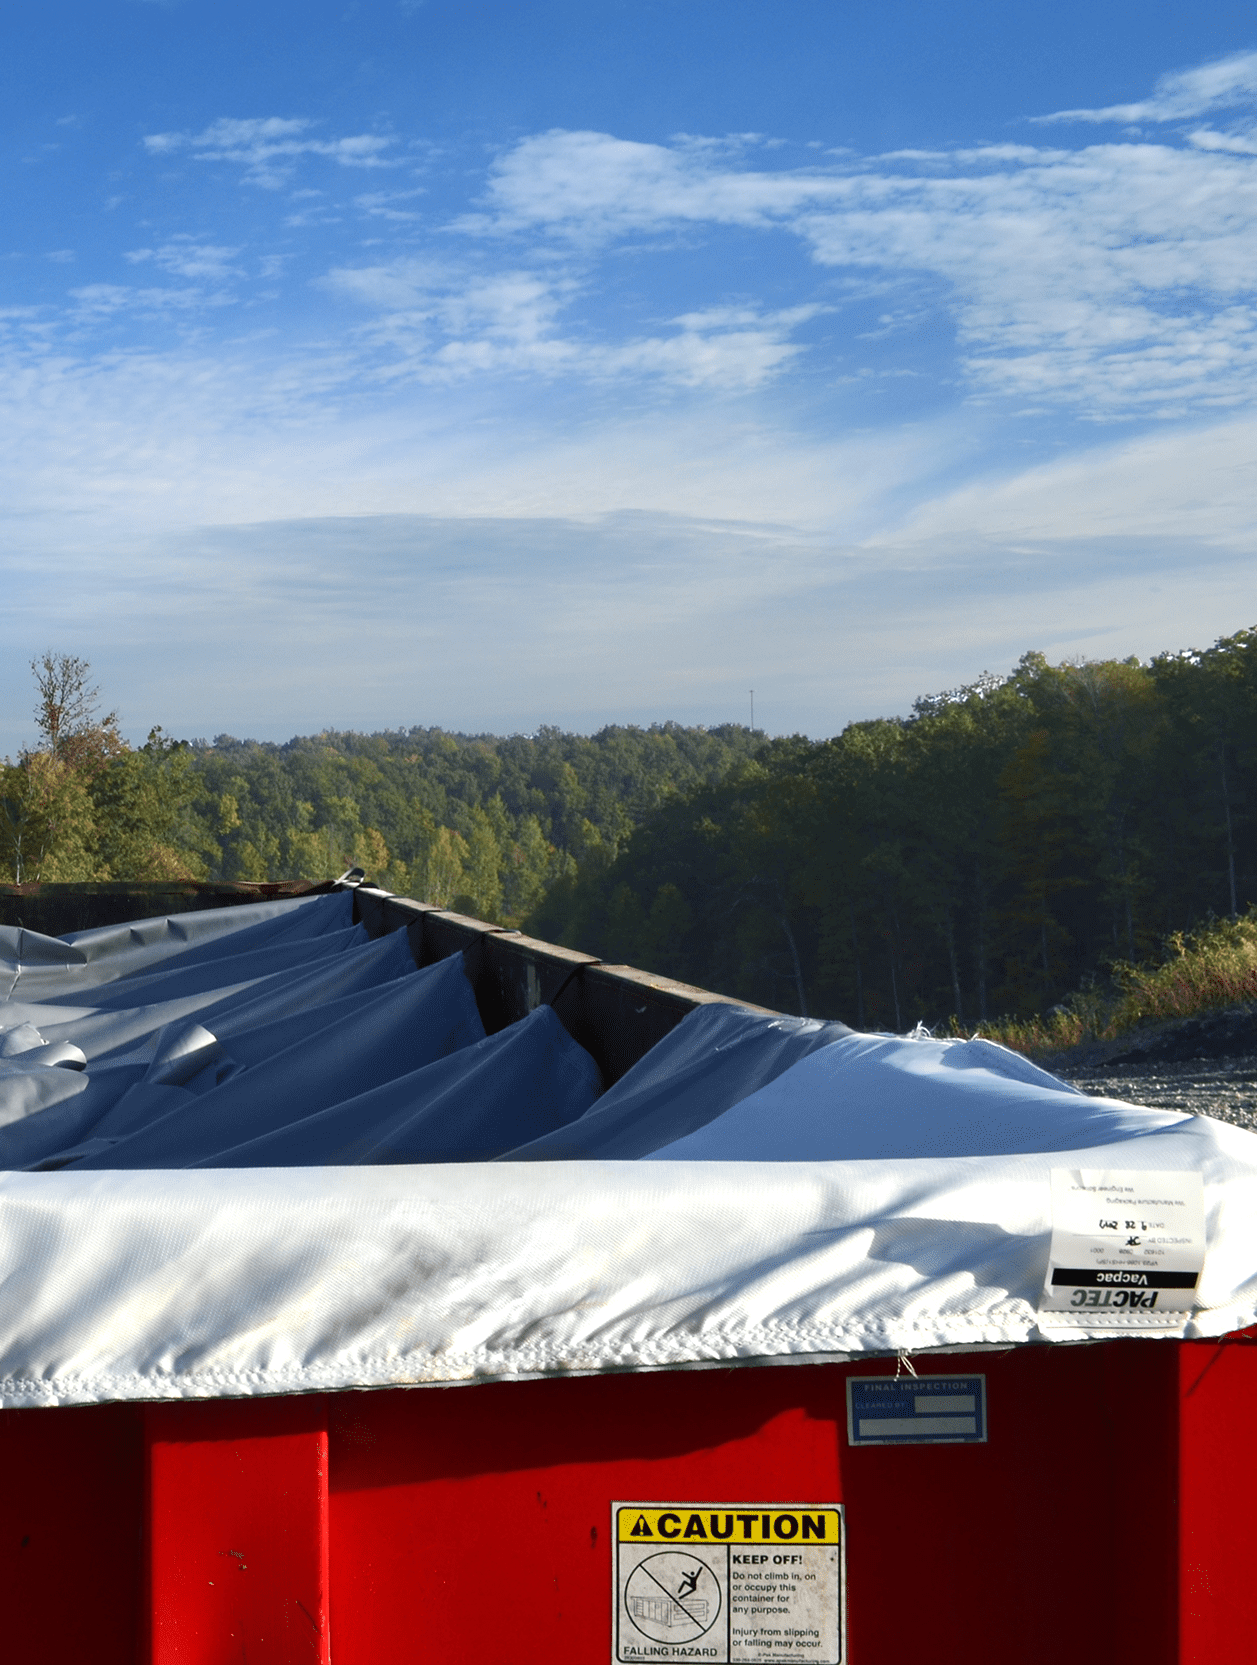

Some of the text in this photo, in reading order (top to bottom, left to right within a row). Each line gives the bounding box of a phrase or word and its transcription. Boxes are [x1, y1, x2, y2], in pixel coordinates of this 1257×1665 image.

[1106, 1197, 1137, 1205] Packaging
[1096, 1271, 1148, 1286] Vacpac
[1070, 1289, 1159, 1308] PACTEC
[864, 1382, 968, 1392] FINAL INSPECTION
[657, 1513, 826, 1539] CAUTION
[732, 1555, 802, 1564] KEEP OFF!
[732, 1572, 745, 1580] Do
[764, 1572, 789, 1580] climb
[791, 1572, 802, 1581] in,
[744, 1584, 777, 1592] occupy
[751, 1607, 790, 1615] purpose.
[732, 1628, 758, 1637] Injury
[784, 1628, 819, 1638] slipping
[744, 1639, 772, 1648] falling
[623, 1646, 718, 1657] FALLING HAZARD
